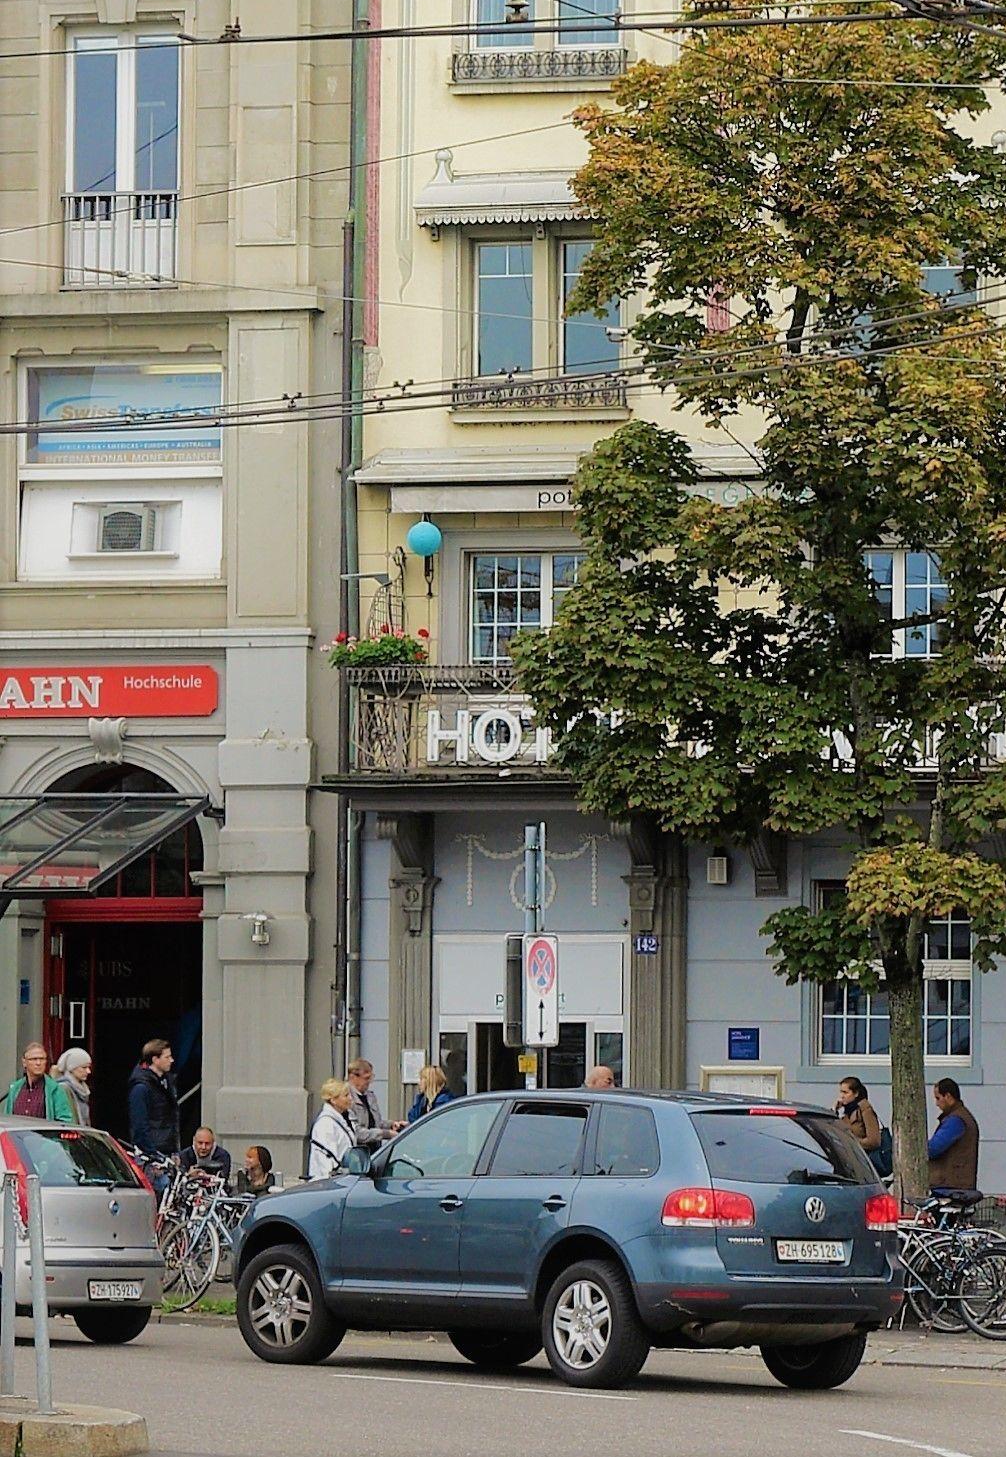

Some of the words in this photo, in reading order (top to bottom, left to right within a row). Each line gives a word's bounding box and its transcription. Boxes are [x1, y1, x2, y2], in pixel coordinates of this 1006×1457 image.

[131, 452, 169, 463] MONEY
[123, 674, 202, 689] Hochschule
[0, 676, 103, 709] AHN
[636, 937, 656, 952] 142
[97, 997, 151, 1009] BAHN
[785, 1244, 798, 1257] ZH
